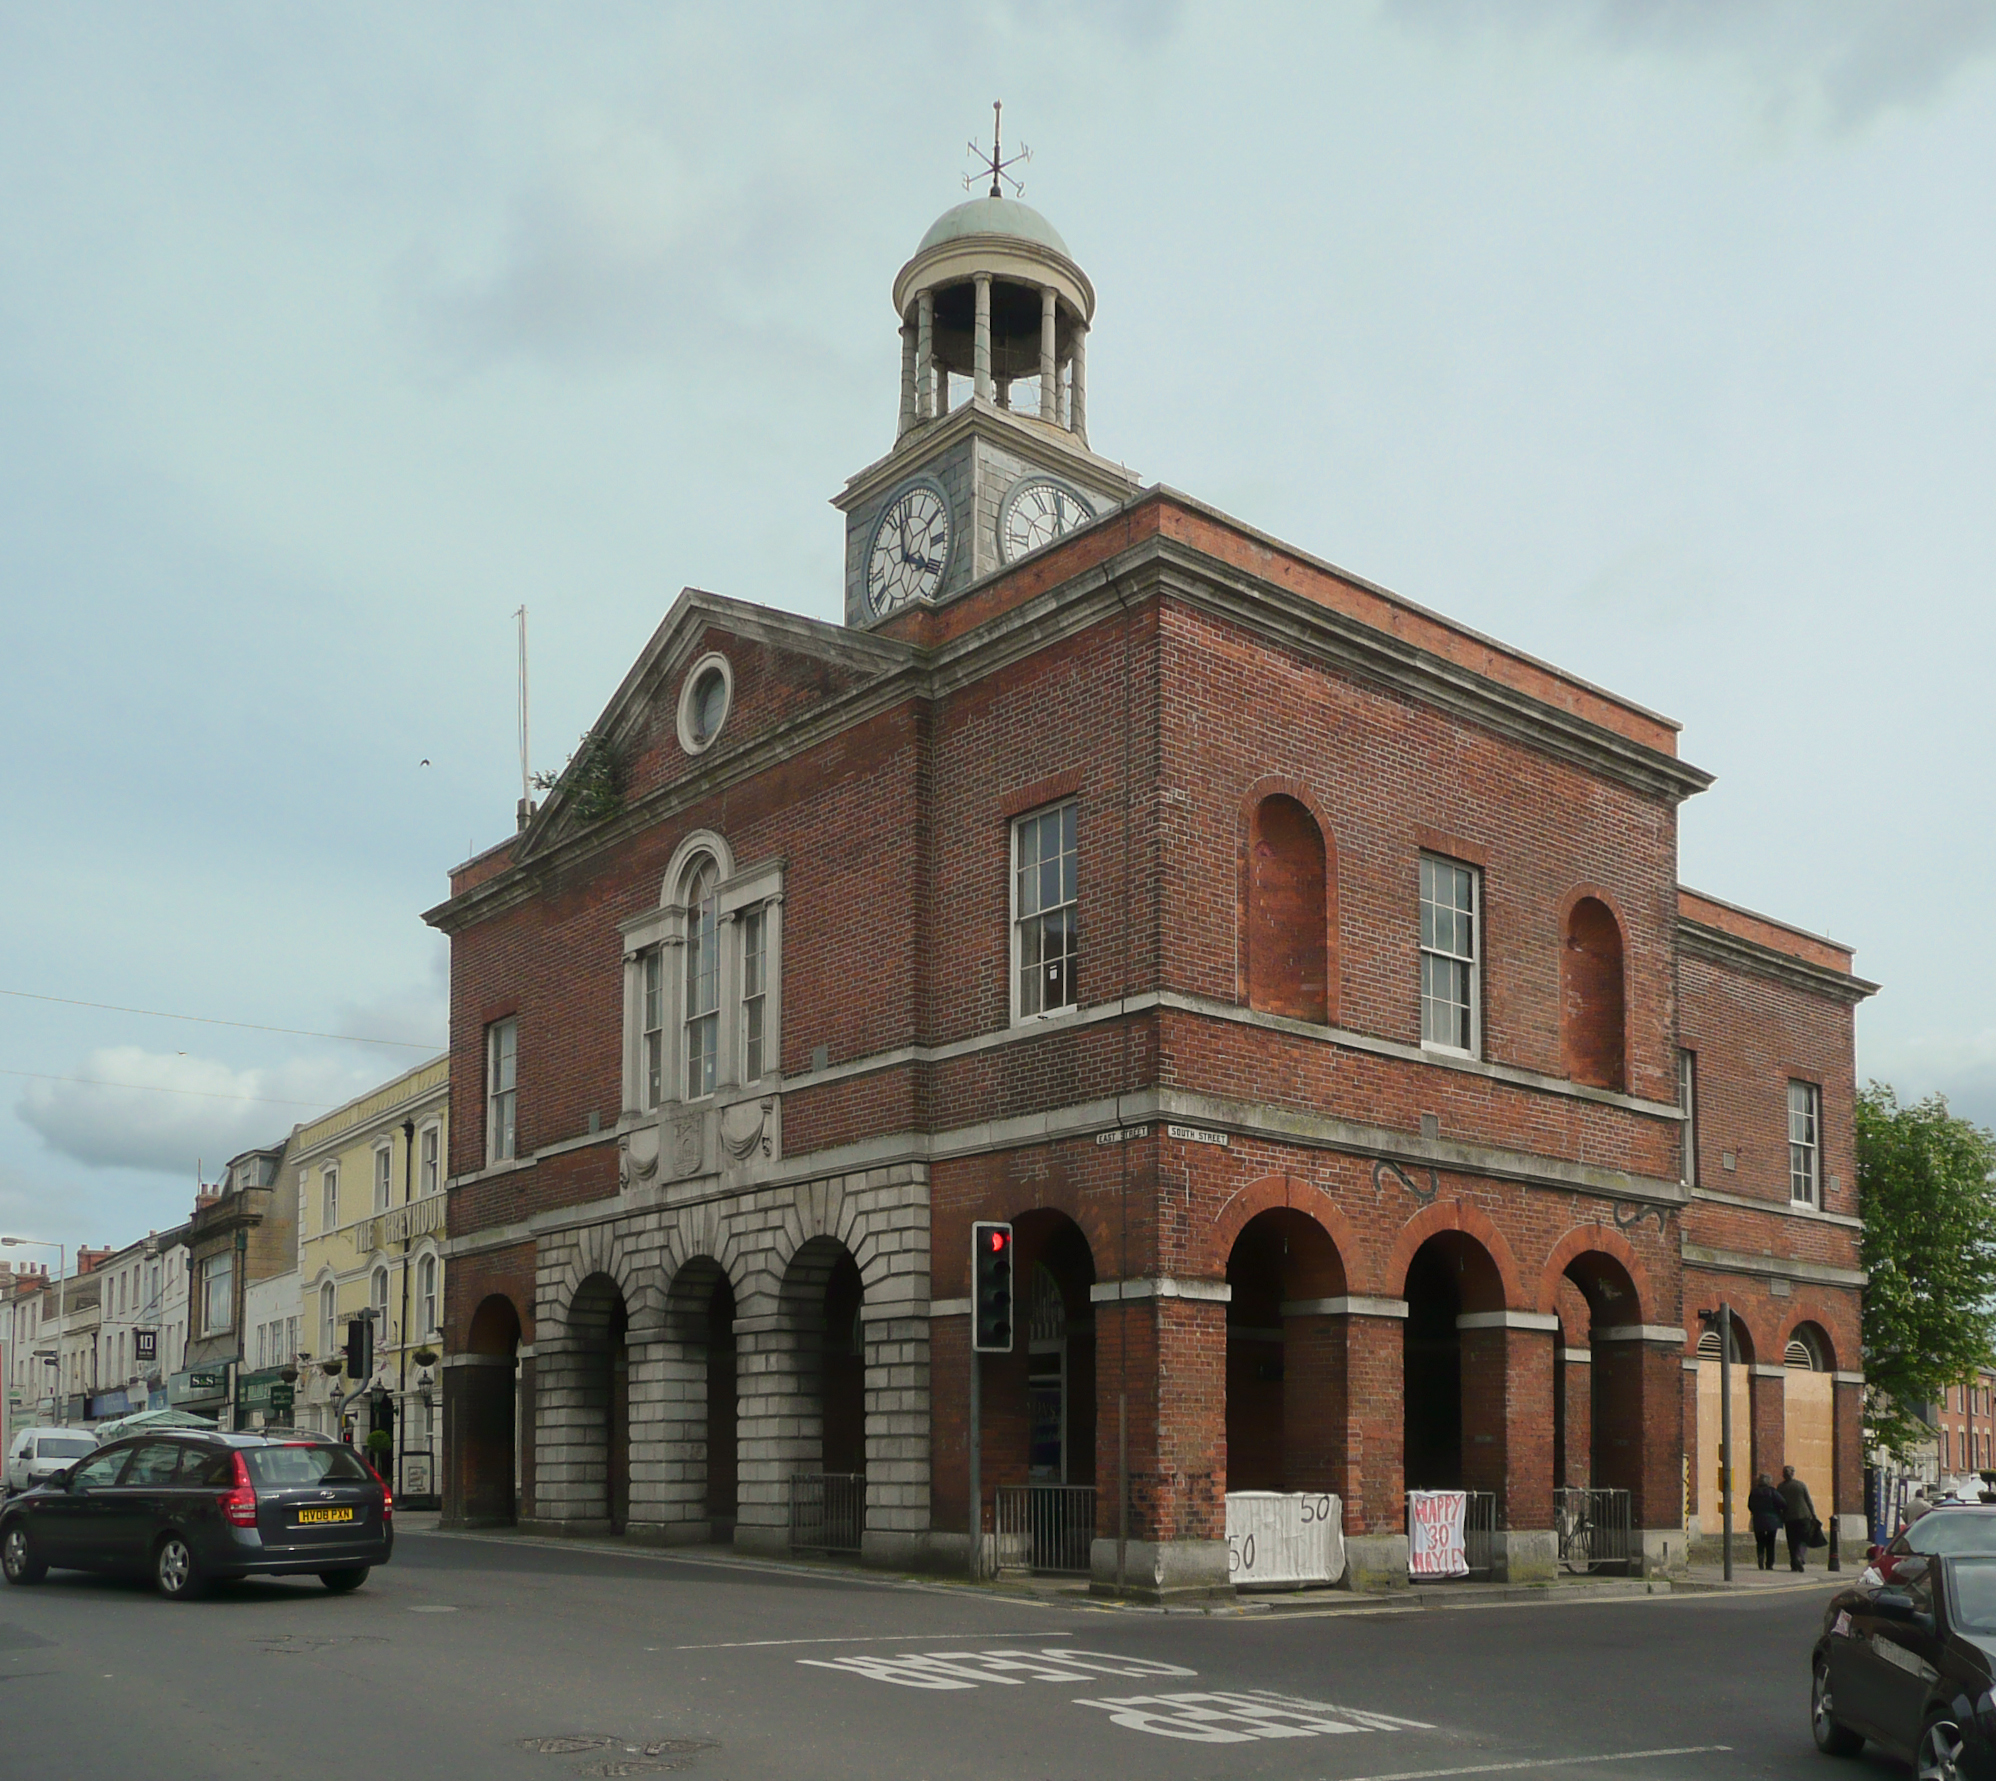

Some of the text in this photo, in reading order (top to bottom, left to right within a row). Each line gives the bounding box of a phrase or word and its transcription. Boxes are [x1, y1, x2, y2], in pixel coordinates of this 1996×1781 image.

[1099, 1126, 1146, 1144] EAST STREET
[1171, 1127, 1226, 1144] SOUTH STREET
[354, 1194, 446, 1254] THE GREYHOUN
[303, 1508, 350, 1521] HV08 PXN
[1300, 1494, 1330, 1523] 50
[1415, 1494, 1464, 1523] HAPPY
[1229, 1534, 1256, 1573] 50
[795, 1648, 1198, 1690] CLEAR
[1071, 1689, 1438, 1743] KEEP
